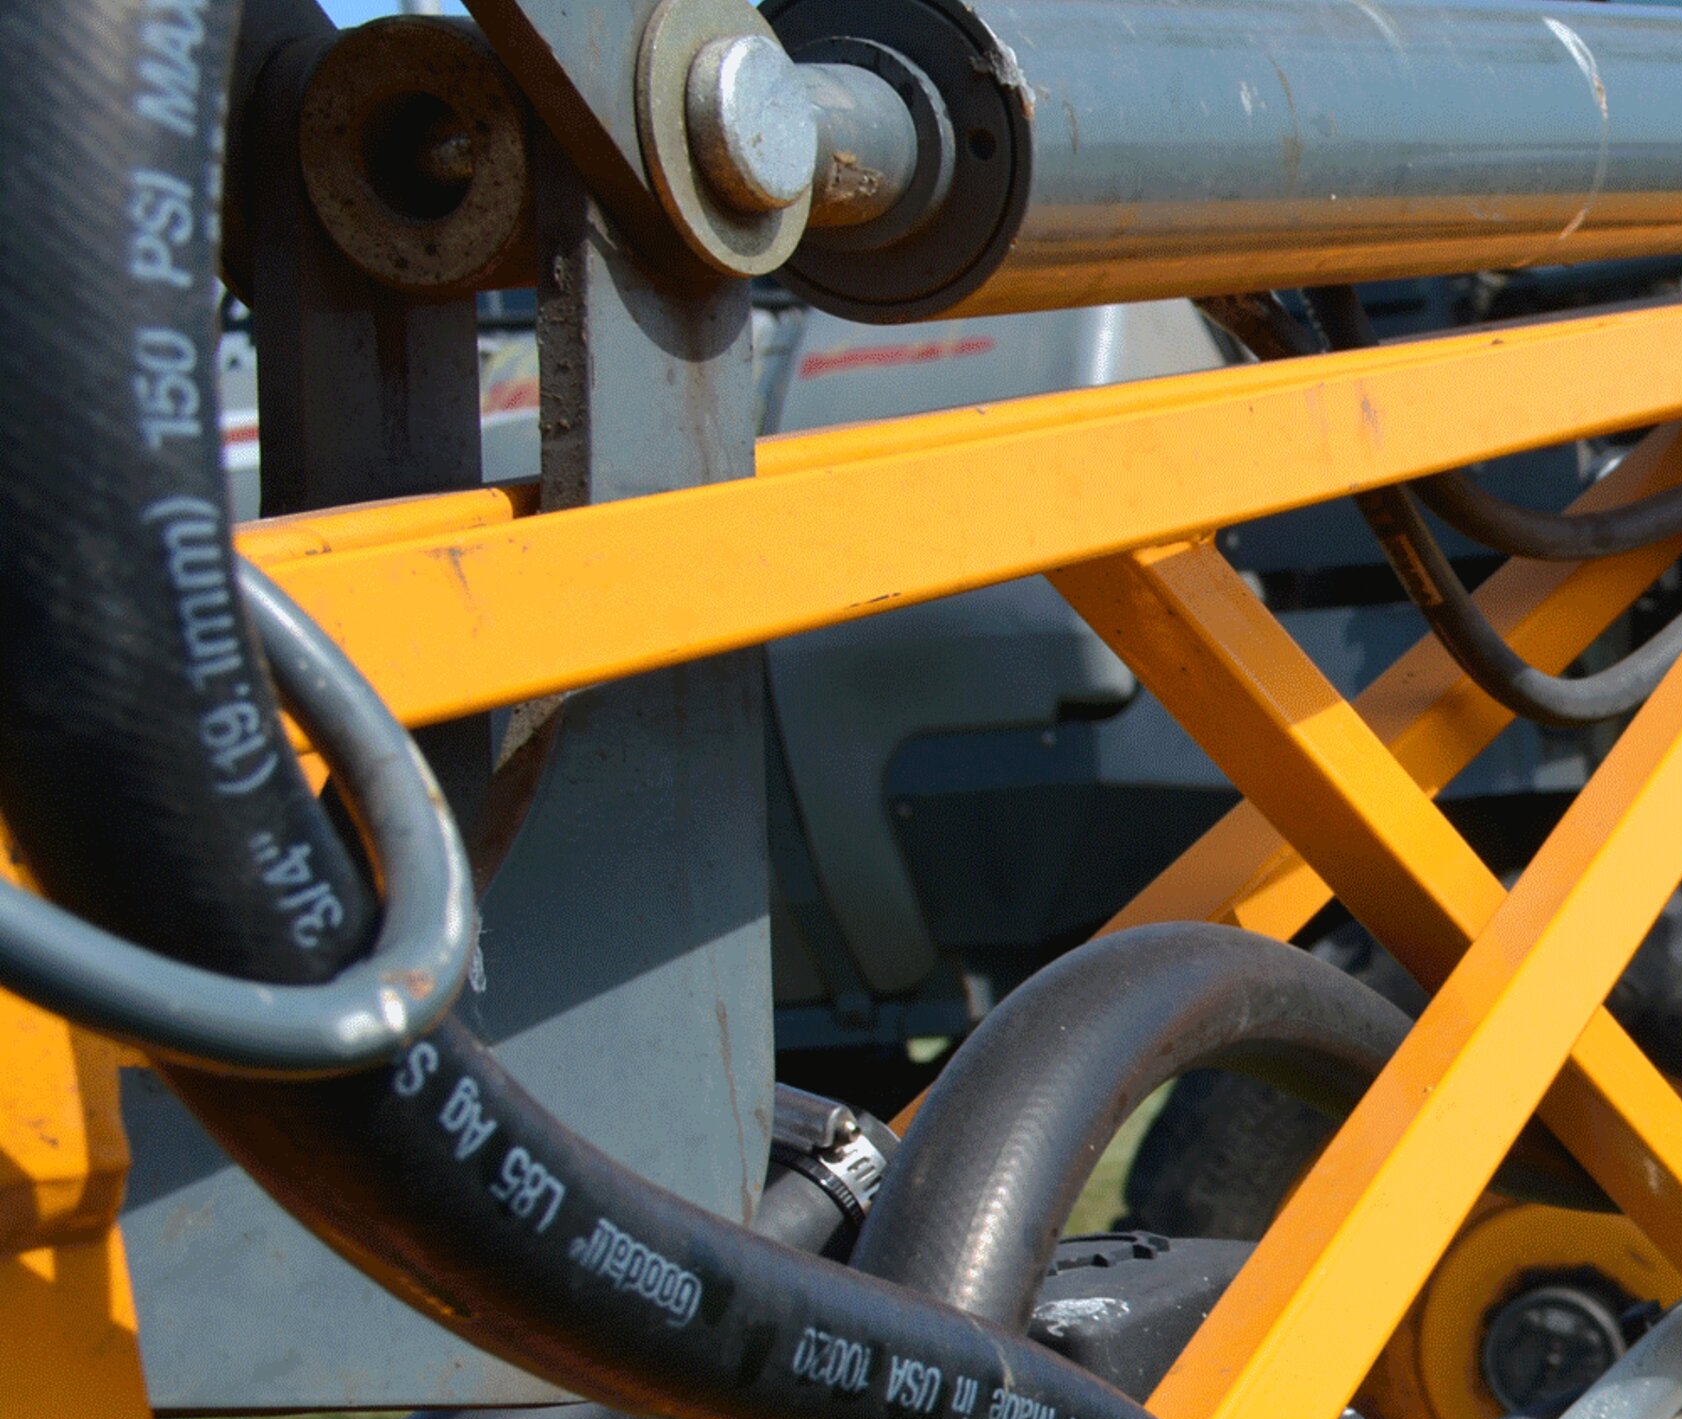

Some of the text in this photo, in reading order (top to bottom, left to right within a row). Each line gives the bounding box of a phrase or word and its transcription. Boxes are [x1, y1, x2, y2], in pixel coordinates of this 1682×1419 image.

[130, 168, 195, 289] PSI
[133, 326, 203, 450] 150
[438, 1075, 498, 1161] Ag
[490, 1146, 566, 1234] L85
[886, 1354, 942, 1414] USA
